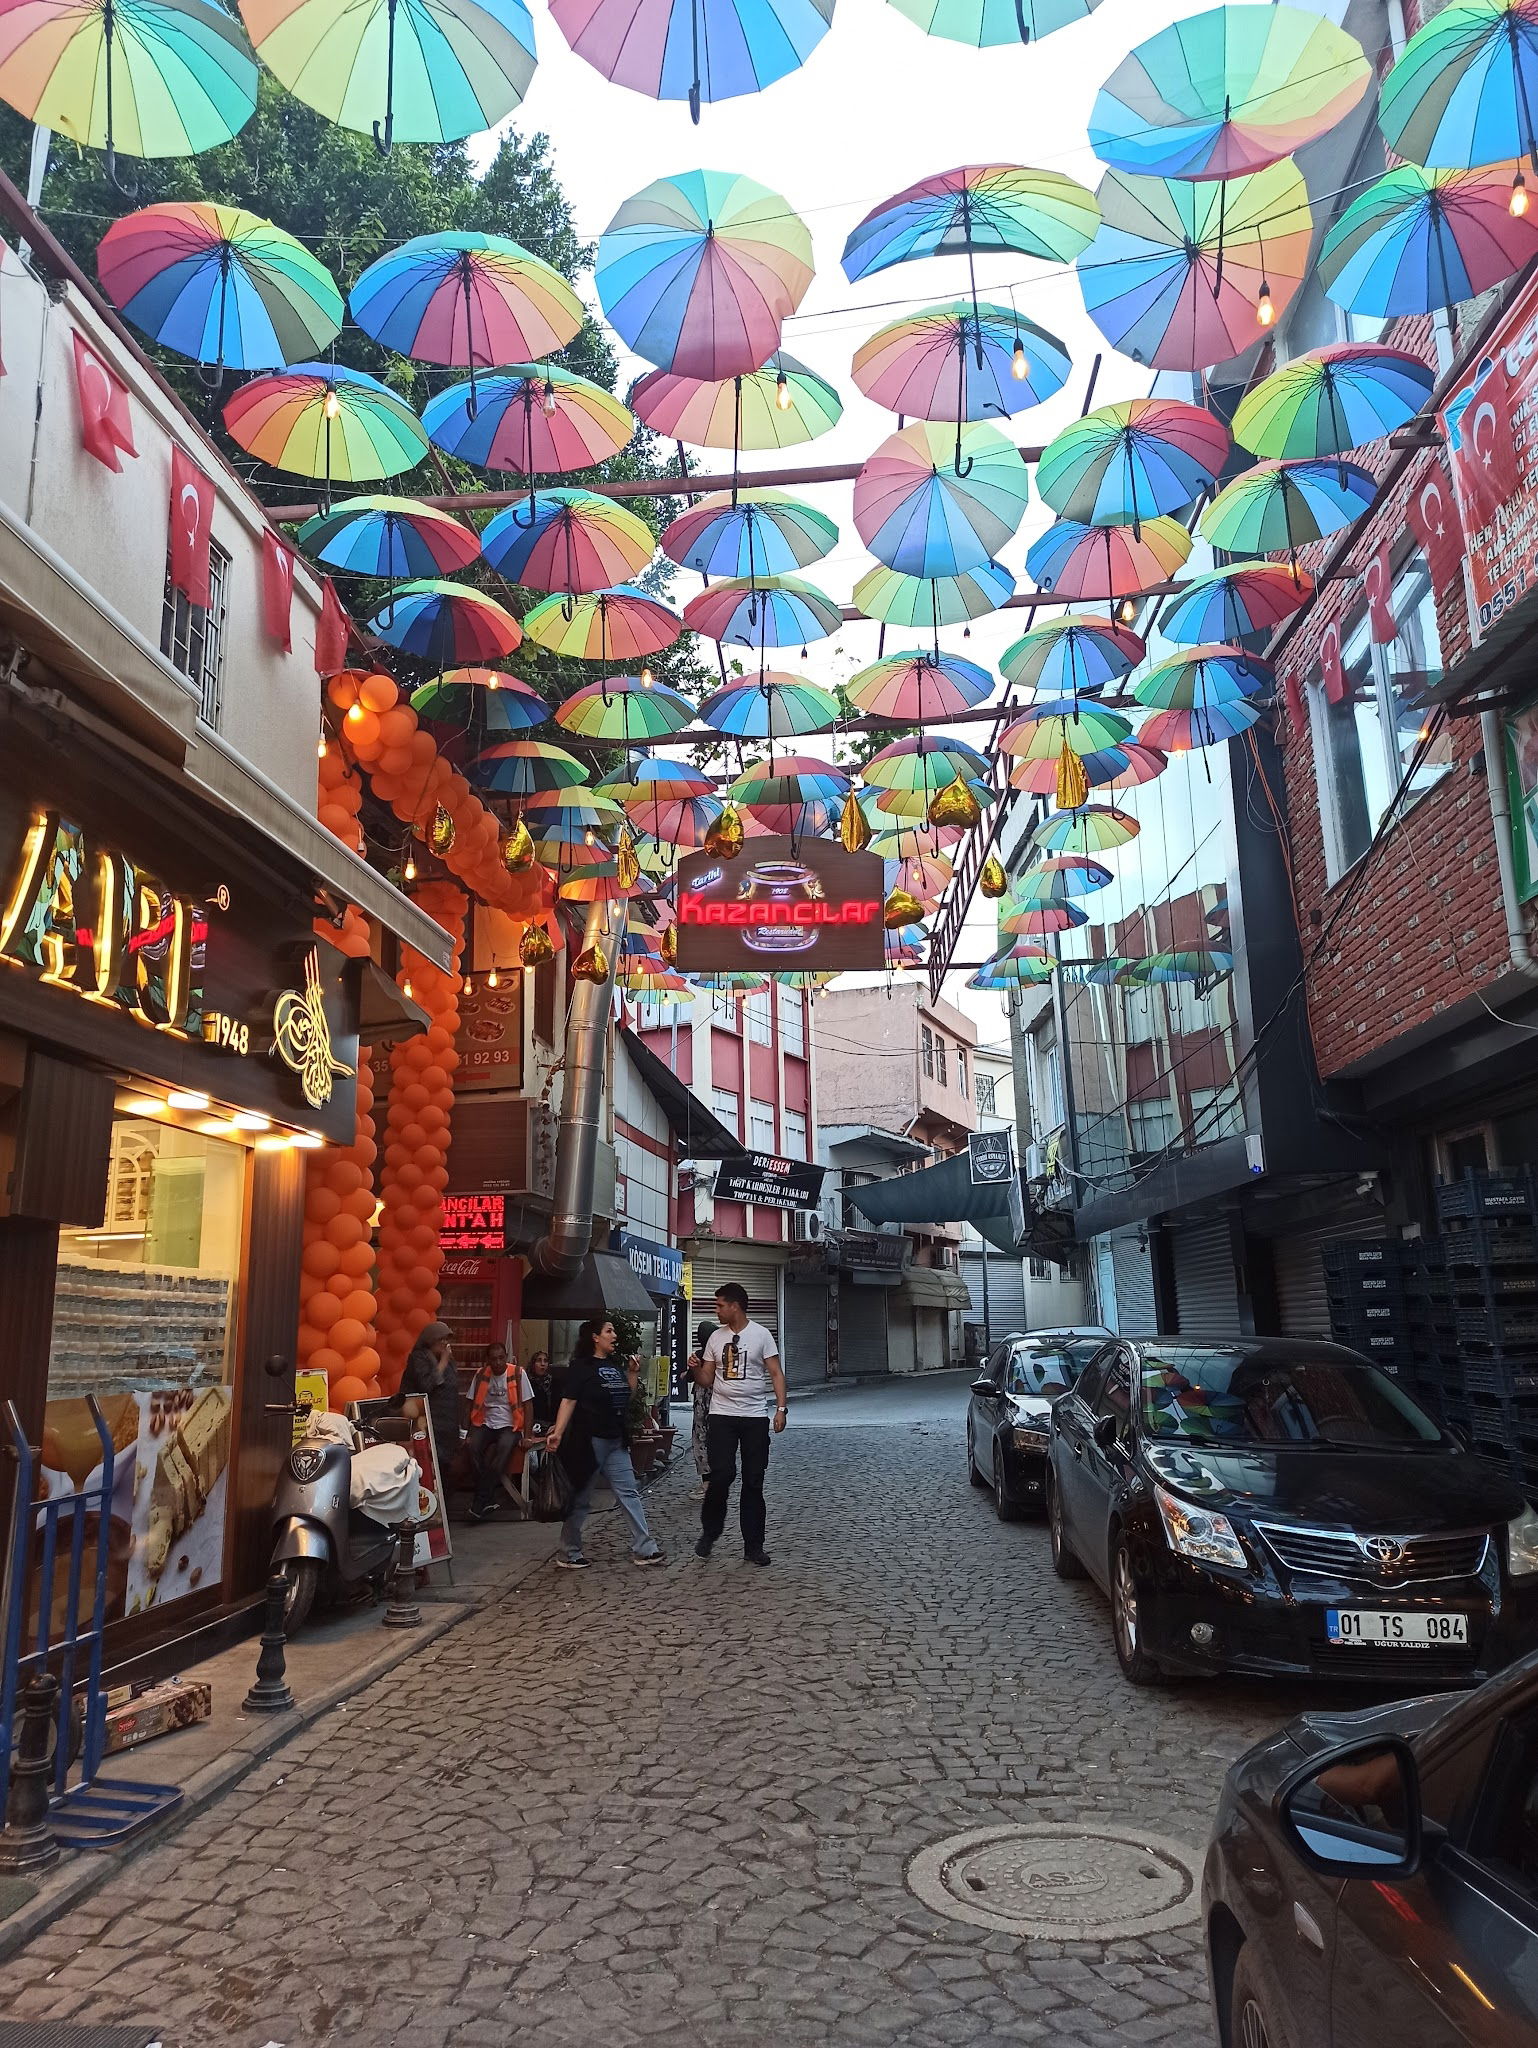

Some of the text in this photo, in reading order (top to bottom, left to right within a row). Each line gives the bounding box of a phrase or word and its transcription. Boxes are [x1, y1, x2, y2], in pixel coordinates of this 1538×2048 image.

[1479, 566, 1527, 628] 0551
[215, 1013, 249, 1055] 1948
[474, 1052, 490, 1065] 92
[493, 1050, 510, 1063] 93
[1340, 1614, 1361, 1636] 01
[1379, 1616, 1404, 1637] TS
[1427, 1617, 1464, 1640] 084
